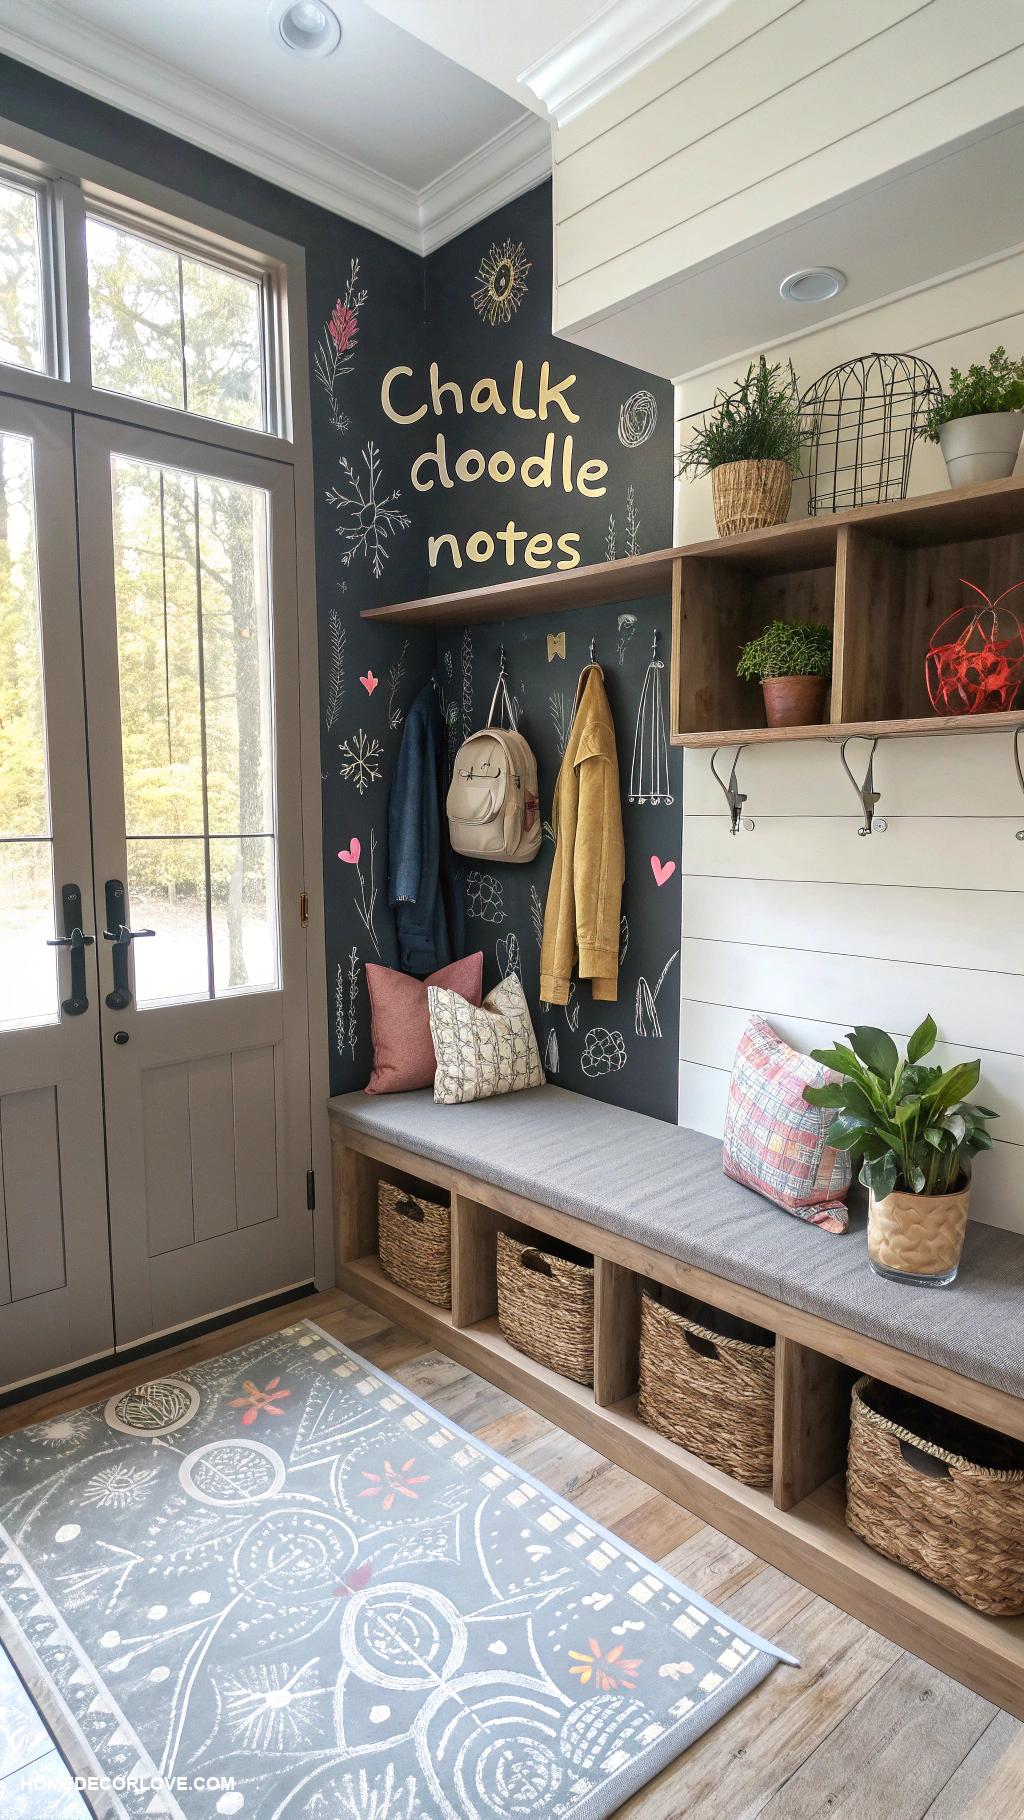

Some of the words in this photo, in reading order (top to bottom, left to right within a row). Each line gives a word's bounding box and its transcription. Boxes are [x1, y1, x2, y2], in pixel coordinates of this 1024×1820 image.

[381, 360, 580, 425] Chalk
[410, 433, 609, 498] doodle
[427, 520, 582, 570] notes
